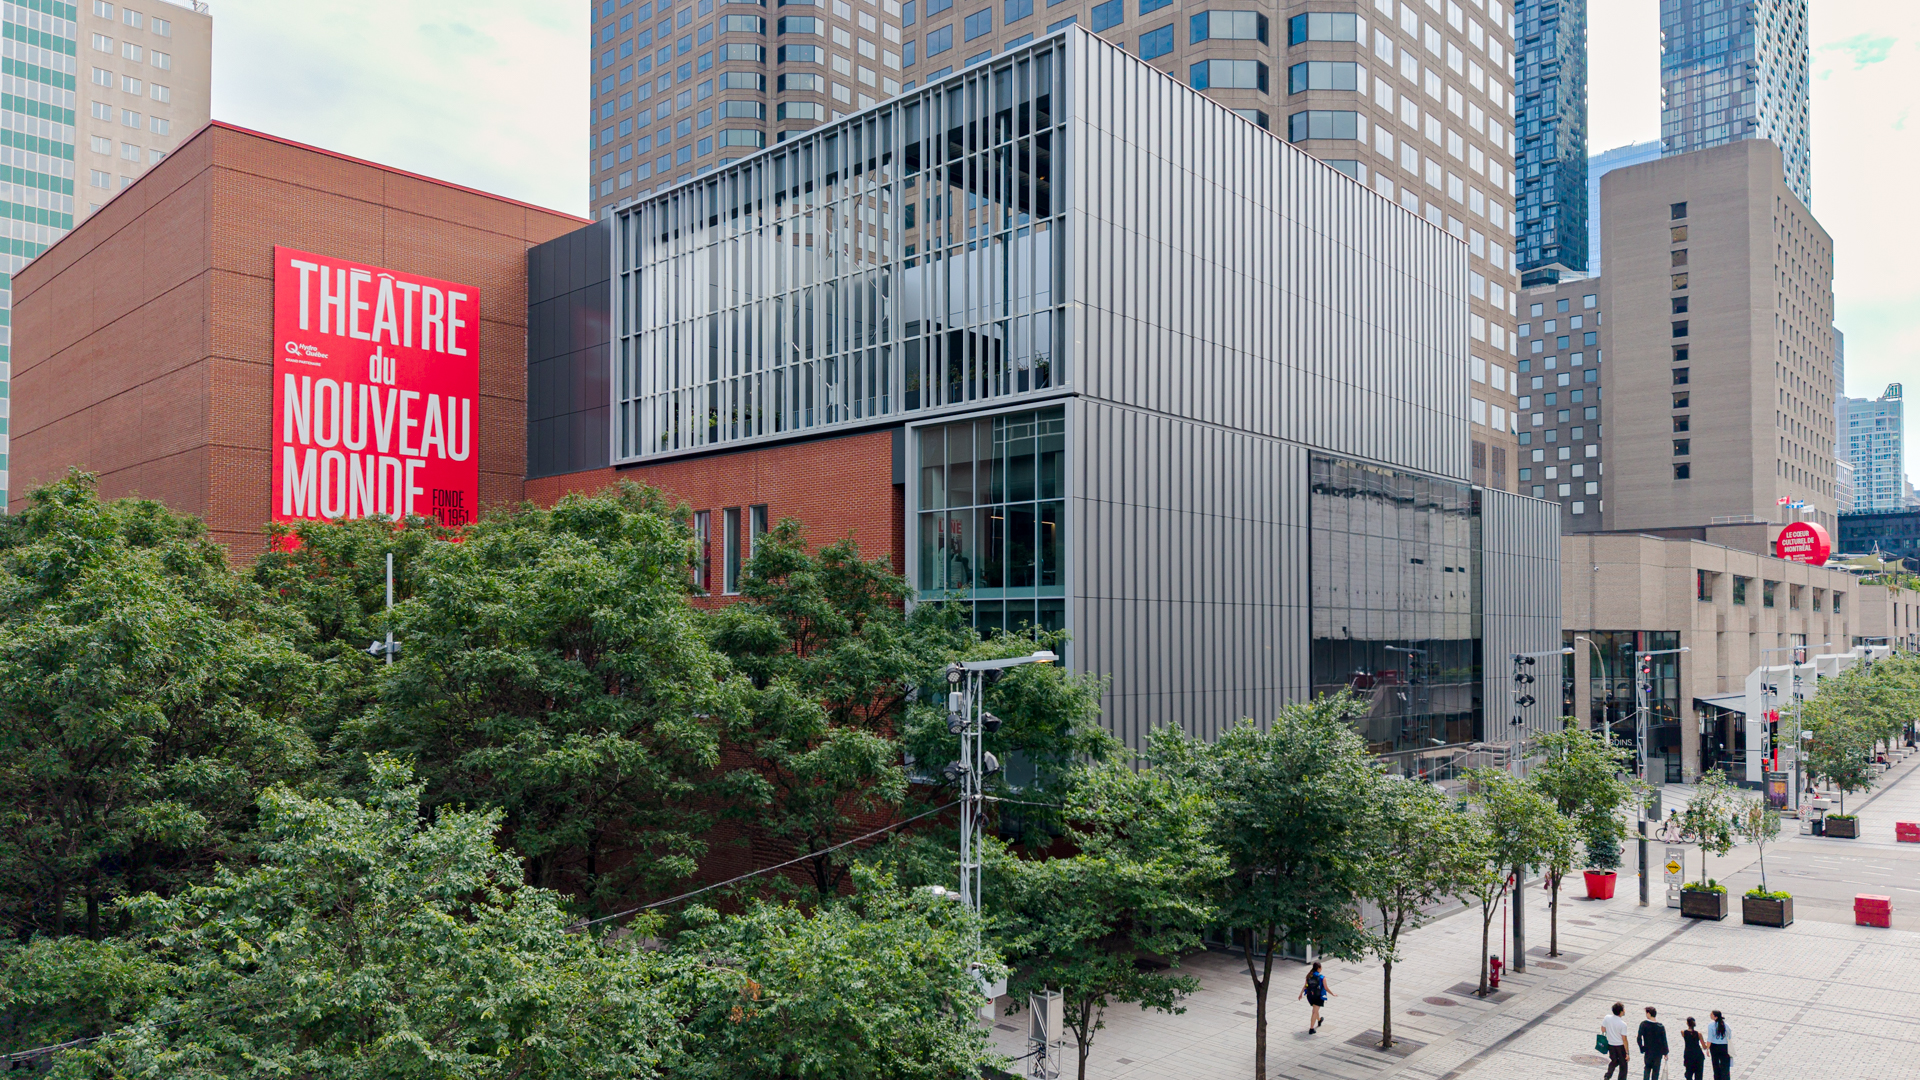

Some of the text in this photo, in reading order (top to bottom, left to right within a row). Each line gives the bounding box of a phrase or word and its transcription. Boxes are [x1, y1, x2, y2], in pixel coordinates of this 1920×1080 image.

[299, 343, 318, 351] Hydro
[305, 350, 329, 359] Québec
[369, 345, 396, 386] du
[283, 373, 471, 462] NOUVEAU
[282, 446, 426, 522] MONDE
[447, 508, 469, 526] 1951
[1782, 538, 1807, 546] CULTUREL
[1784, 544, 1812, 552] MONTRÉAL
